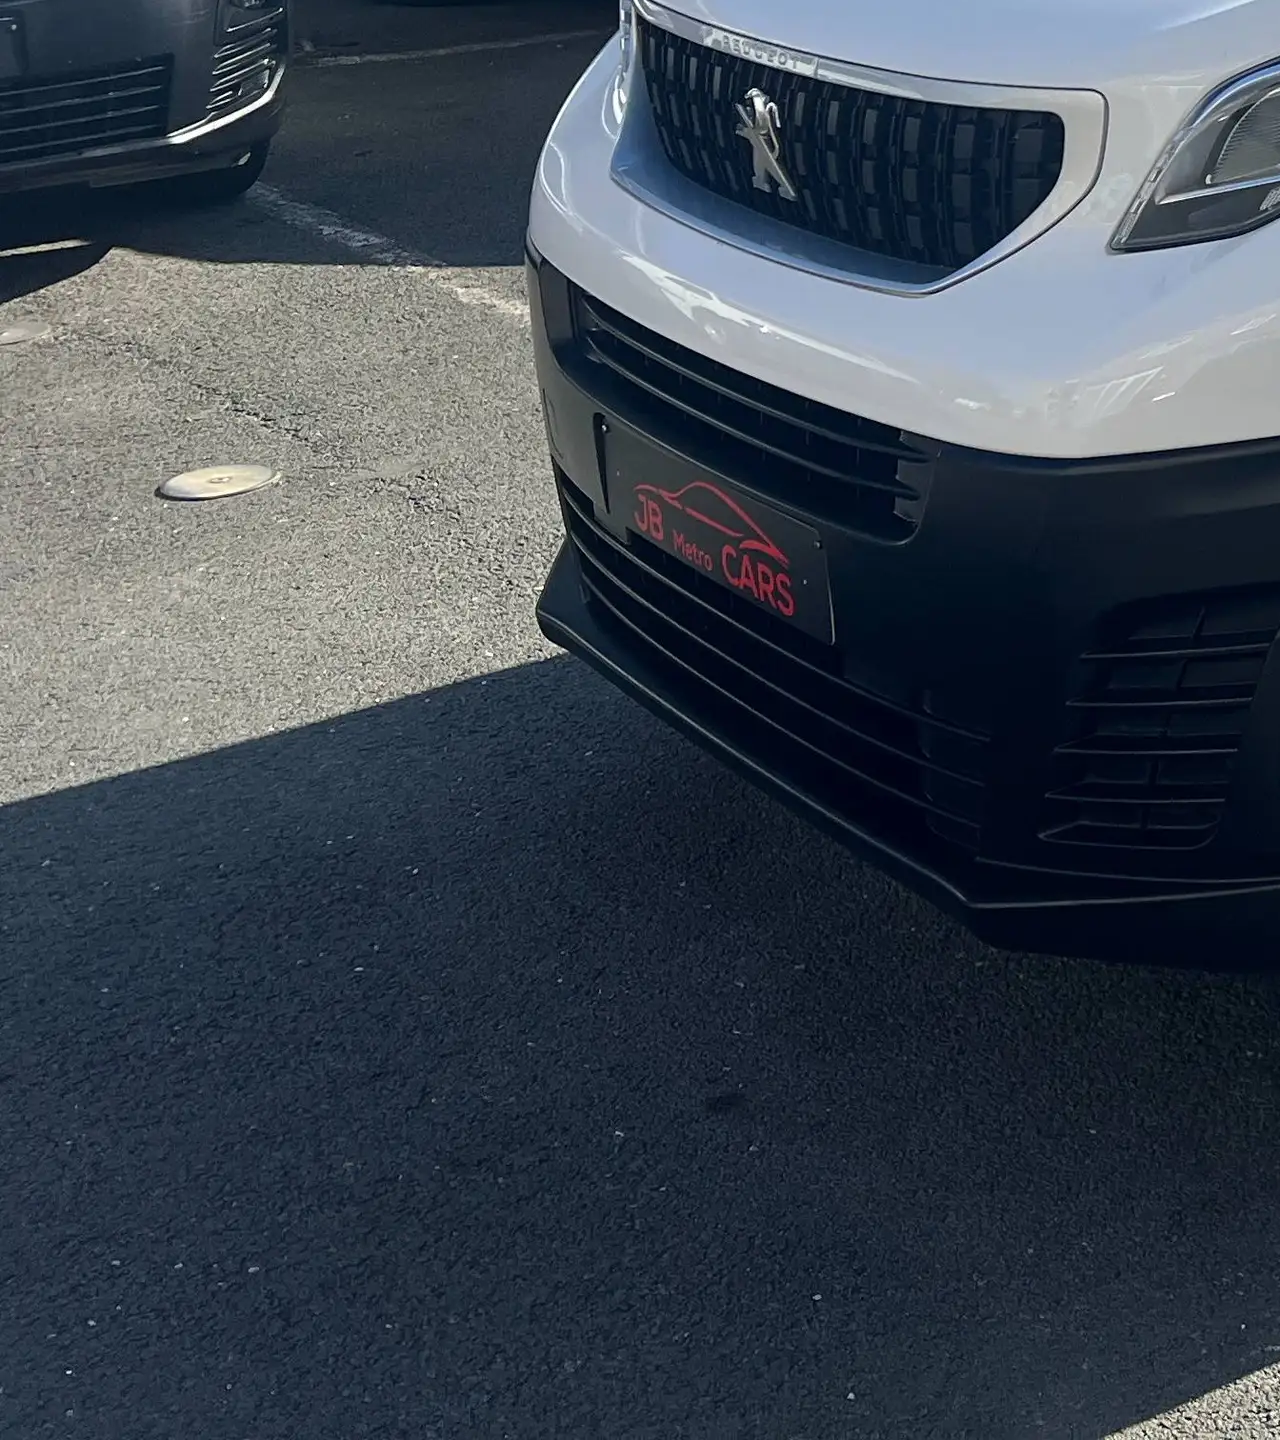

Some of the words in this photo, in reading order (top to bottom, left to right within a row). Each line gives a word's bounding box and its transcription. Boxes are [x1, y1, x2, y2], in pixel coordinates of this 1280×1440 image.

[634, 494, 664, 542] JB
[672, 529, 713, 572] Metro
[721, 544, 795, 617] CARS
